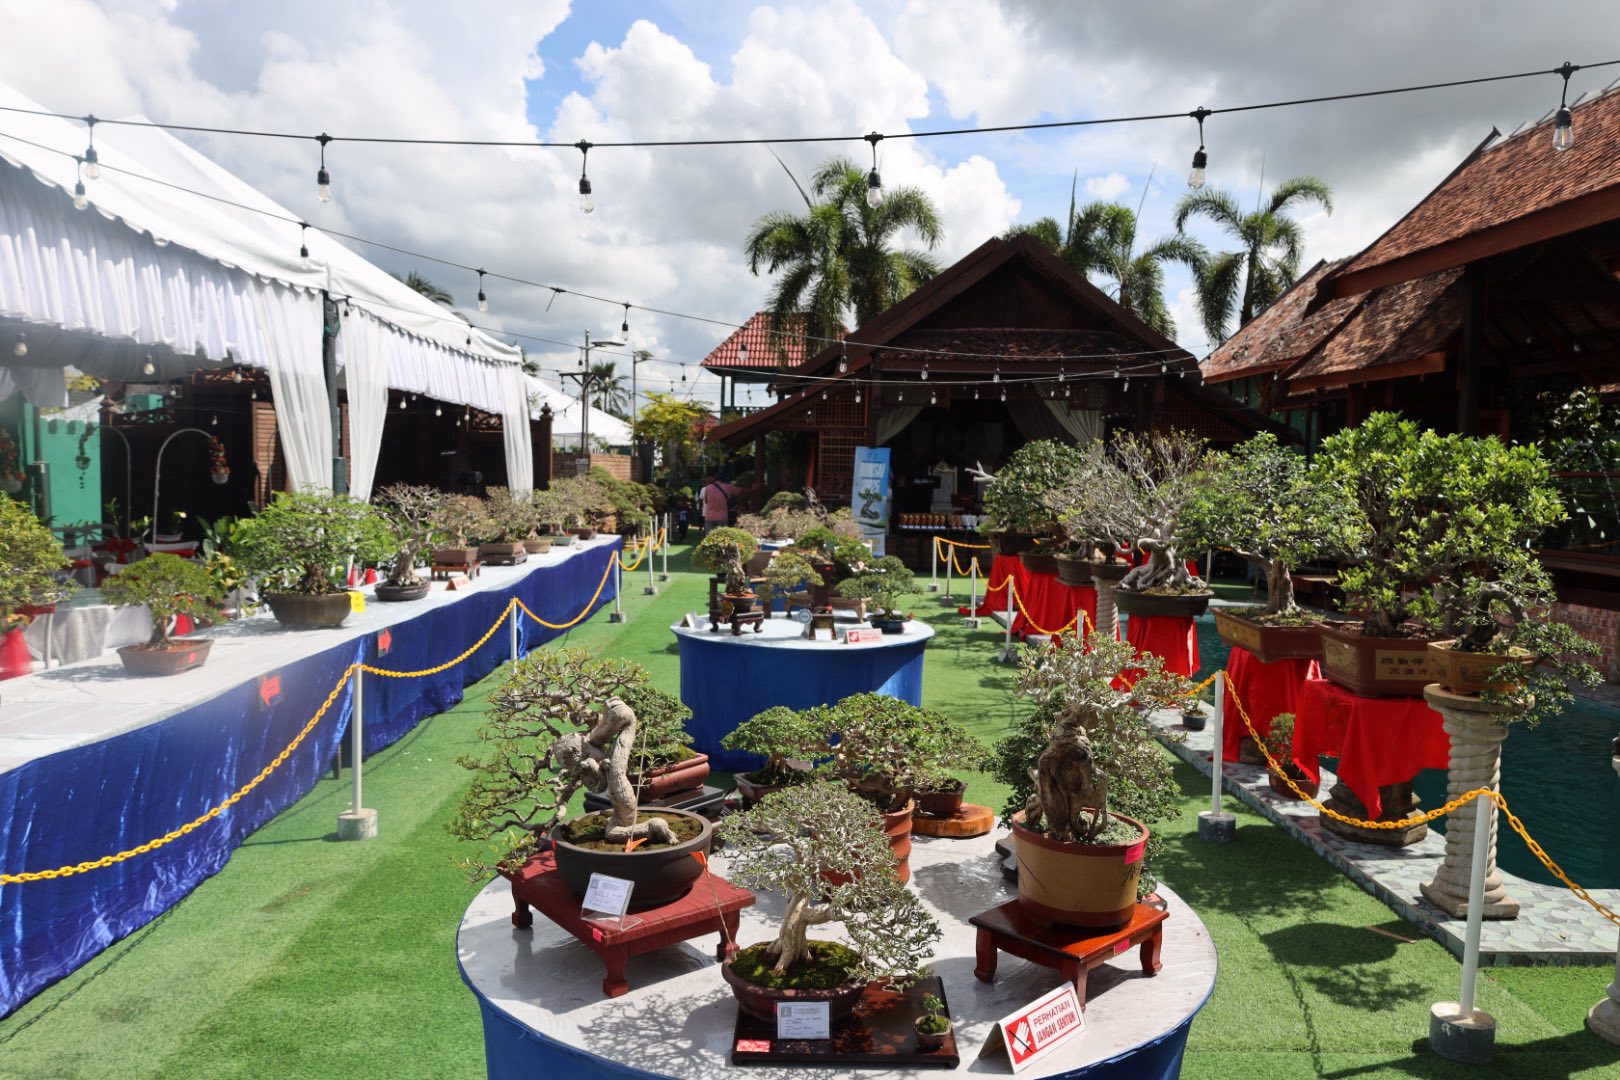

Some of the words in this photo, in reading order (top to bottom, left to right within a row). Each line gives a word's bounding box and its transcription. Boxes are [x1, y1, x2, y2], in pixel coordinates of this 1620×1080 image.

[859, 463, 886, 478] BONSAI
[1033, 1000, 1071, 1028] PERHATIAN
[1036, 1022, 1058, 1043] JANGAN
[1057, 1011, 1076, 1031] SENTUH
